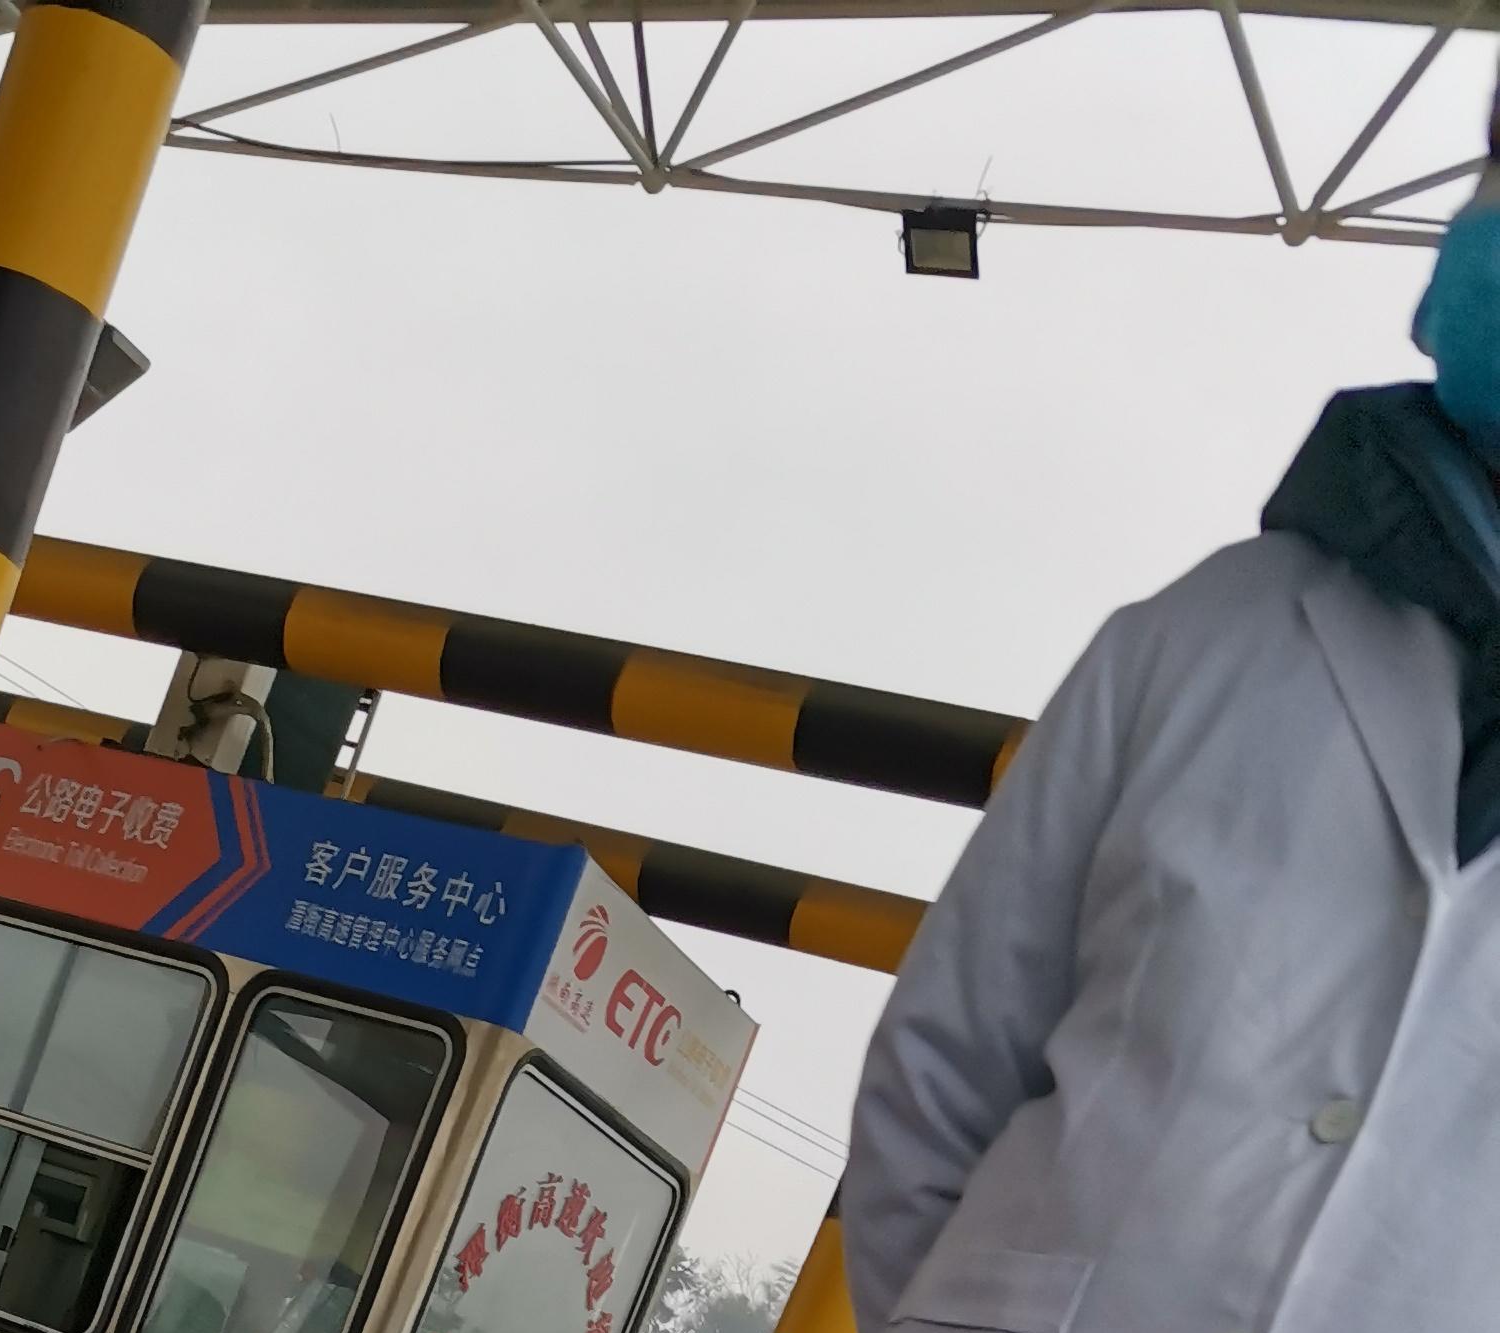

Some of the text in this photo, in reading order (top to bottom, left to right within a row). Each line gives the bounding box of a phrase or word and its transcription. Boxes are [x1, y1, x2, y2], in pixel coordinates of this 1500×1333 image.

[20, 774, 184, 849] 公路电子收费
[304, 840, 505, 925] 客户服务中心
[605, 969, 682, 1067] ETC
